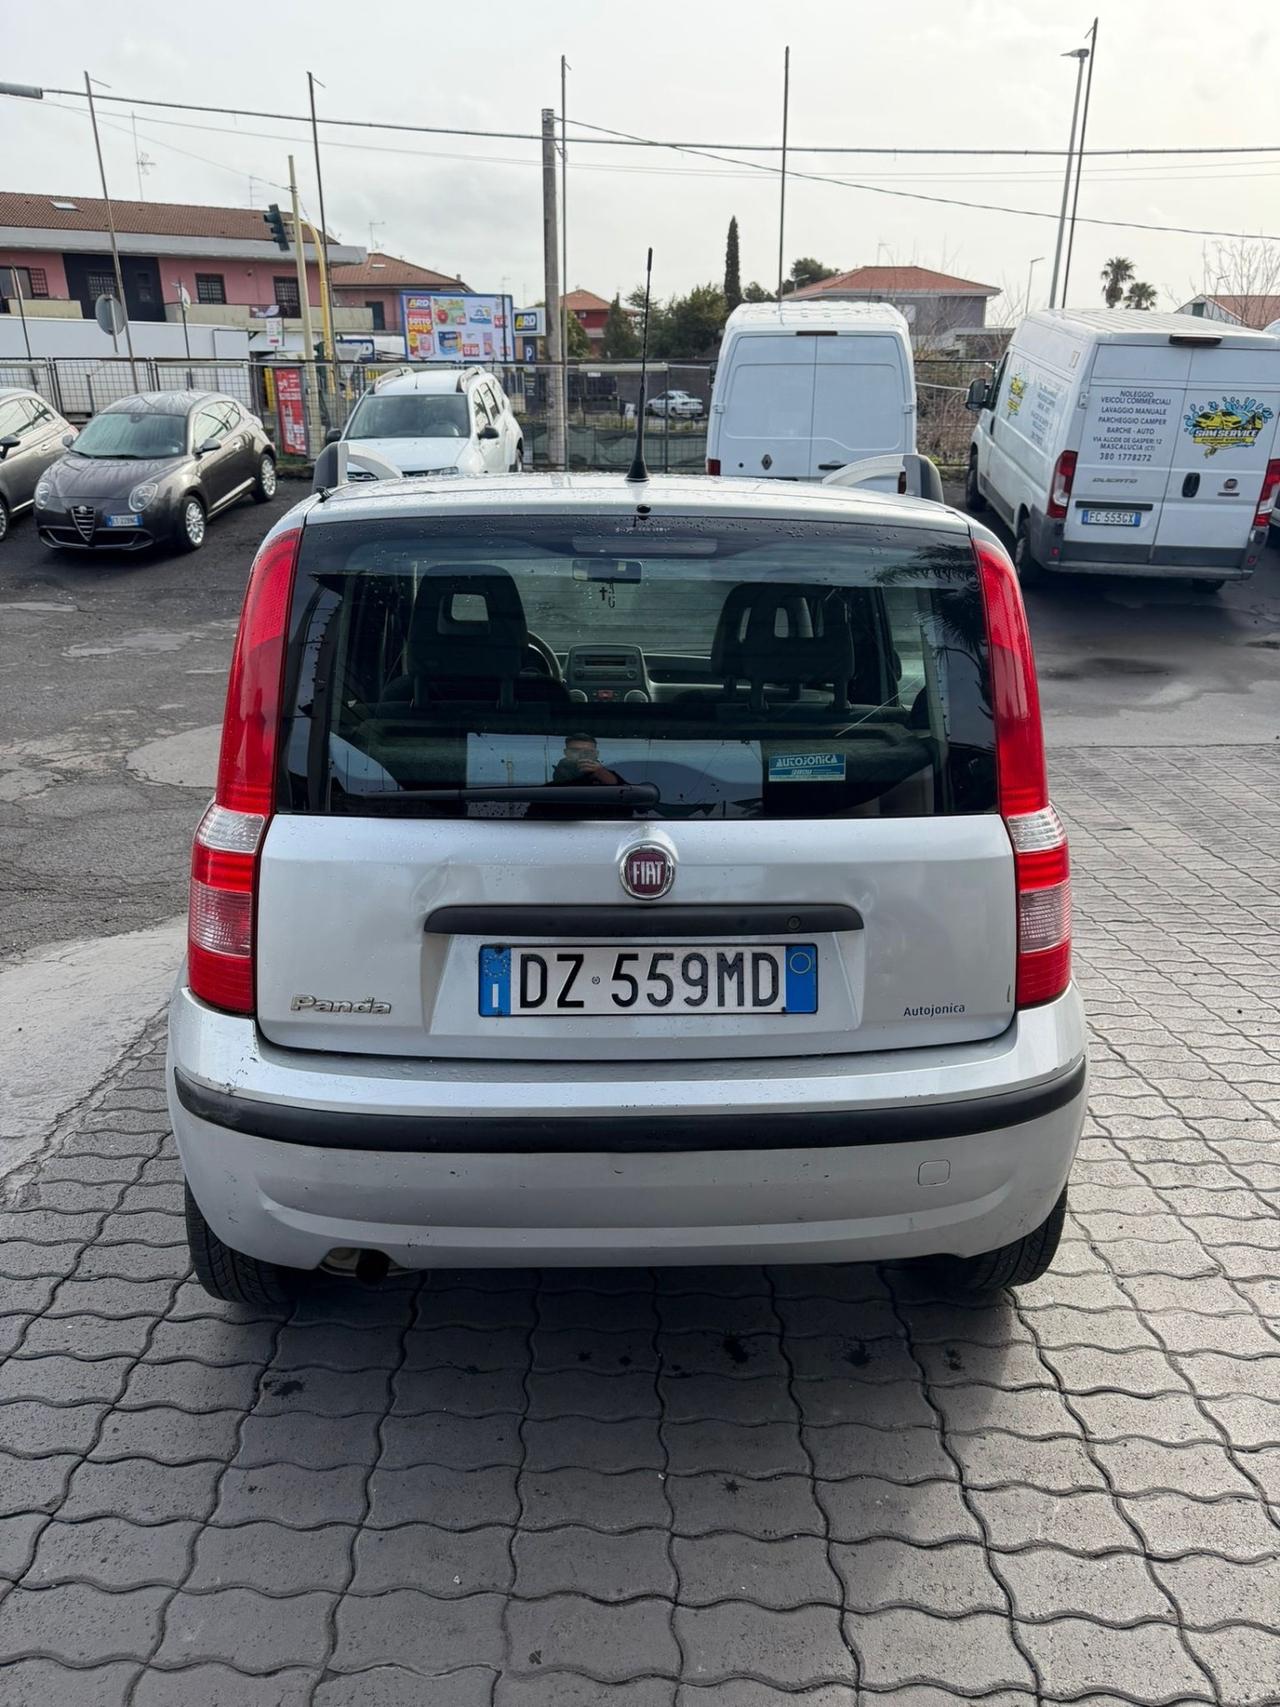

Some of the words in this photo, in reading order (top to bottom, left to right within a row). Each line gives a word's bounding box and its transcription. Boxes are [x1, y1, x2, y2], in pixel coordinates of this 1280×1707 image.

[516, 315, 536, 329] ARD
[1218, 429, 1257, 437] SERVICE
[1099, 452, 1115, 460] 380
[633, 861, 664, 885] FIAT
[520, 953, 584, 1009] DZ
[611, 952, 779, 1008] 559MD
[290, 995, 392, 1014] Panda
[903, 1002, 965, 1017] Autojonica
